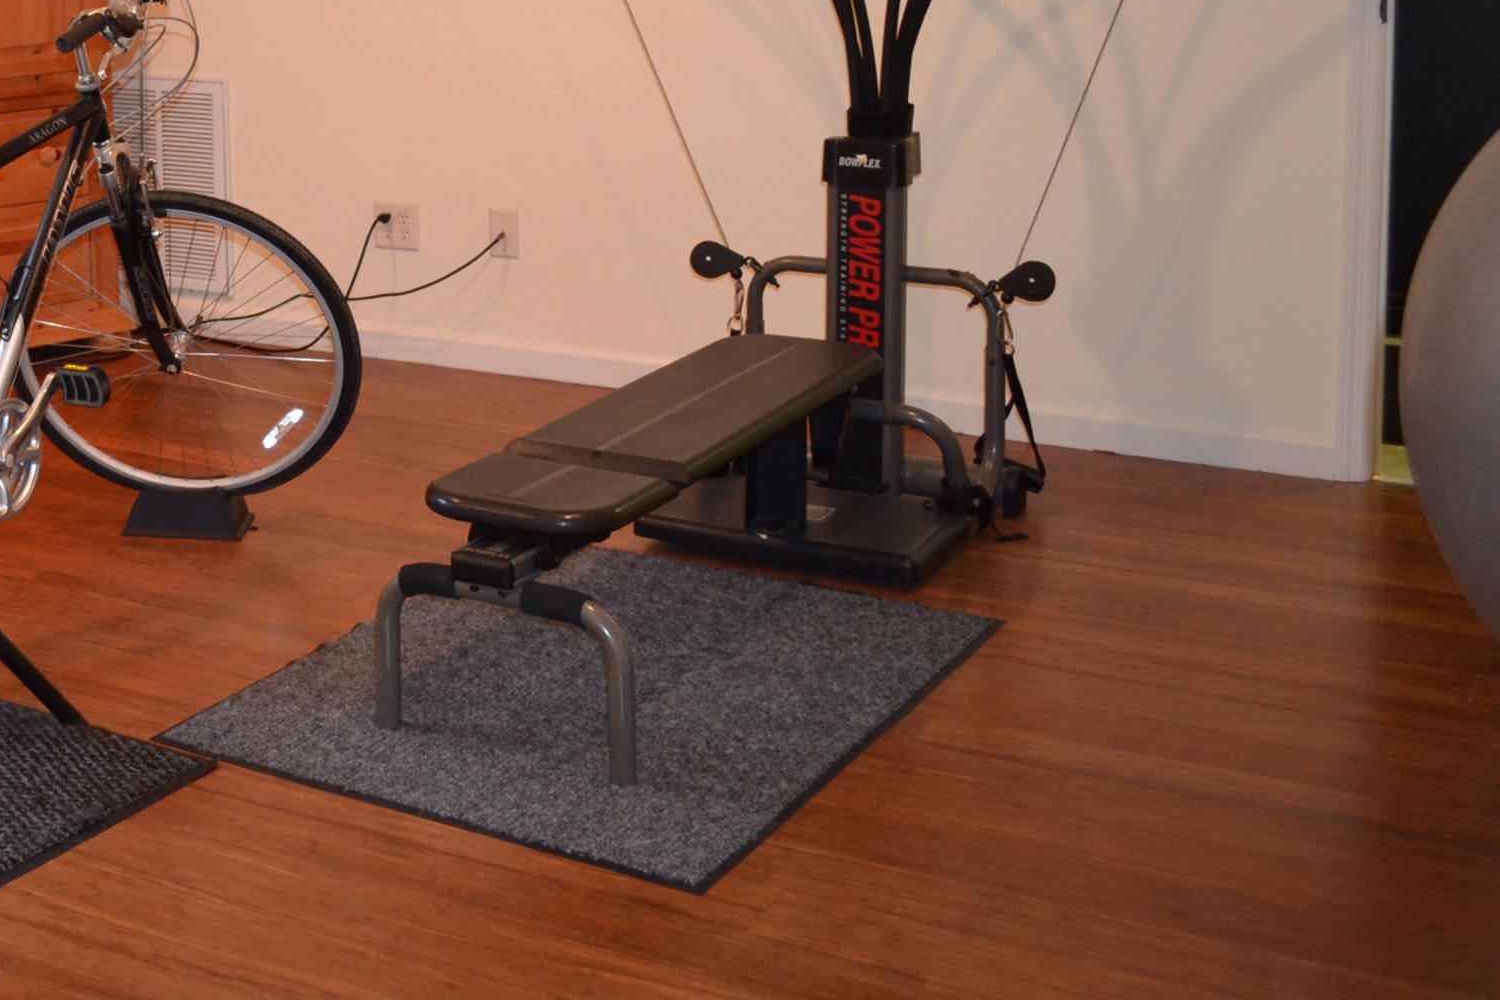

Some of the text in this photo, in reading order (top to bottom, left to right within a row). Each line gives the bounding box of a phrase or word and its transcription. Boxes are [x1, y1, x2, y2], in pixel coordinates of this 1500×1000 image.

[28, 115, 67, 145] ARAGON
[840, 193, 848, 252] STRENGTH
[848, 193, 882, 301] POWER
[839, 258, 847, 312] TRAINING
